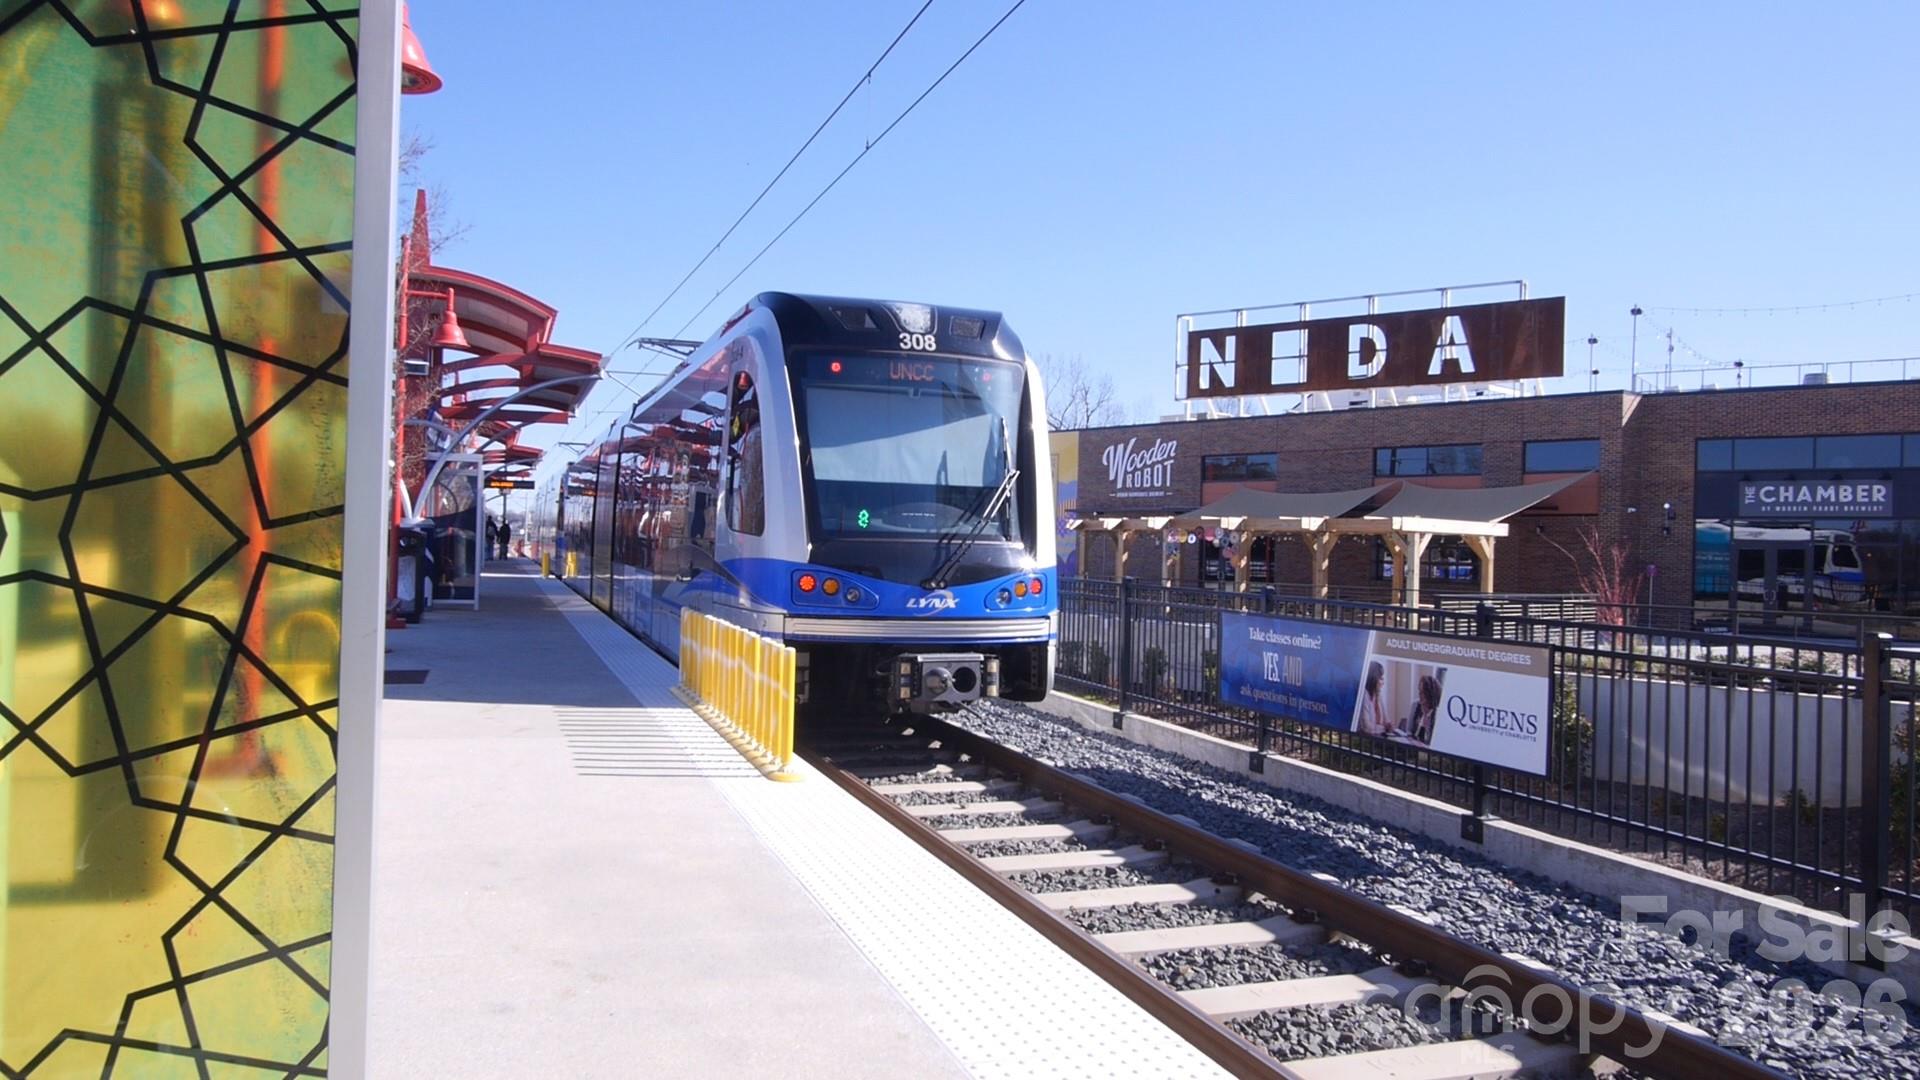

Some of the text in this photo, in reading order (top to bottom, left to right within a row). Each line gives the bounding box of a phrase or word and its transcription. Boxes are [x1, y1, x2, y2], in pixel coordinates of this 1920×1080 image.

[899, 333, 936, 351] 308
[890, 361, 934, 381] UNCC
[1102, 437, 1177, 489] Wooden
[1126, 460, 1174, 488] ROBOT
[1744, 486, 1756, 504] THE
[1759, 485, 1886, 503] CHAMBER
[905, 597, 960, 609] LYNX
[1248, 627, 1322, 649] Take classes online?
[1386, 638, 1532, 665] ADULT UNDERGRADUATE DEGREES
[1282, 655, 1303, 687] AND
[1239, 684, 1252, 696] ask
[1252, 688, 1288, 705] questions
[1289, 693, 1297, 707] in
